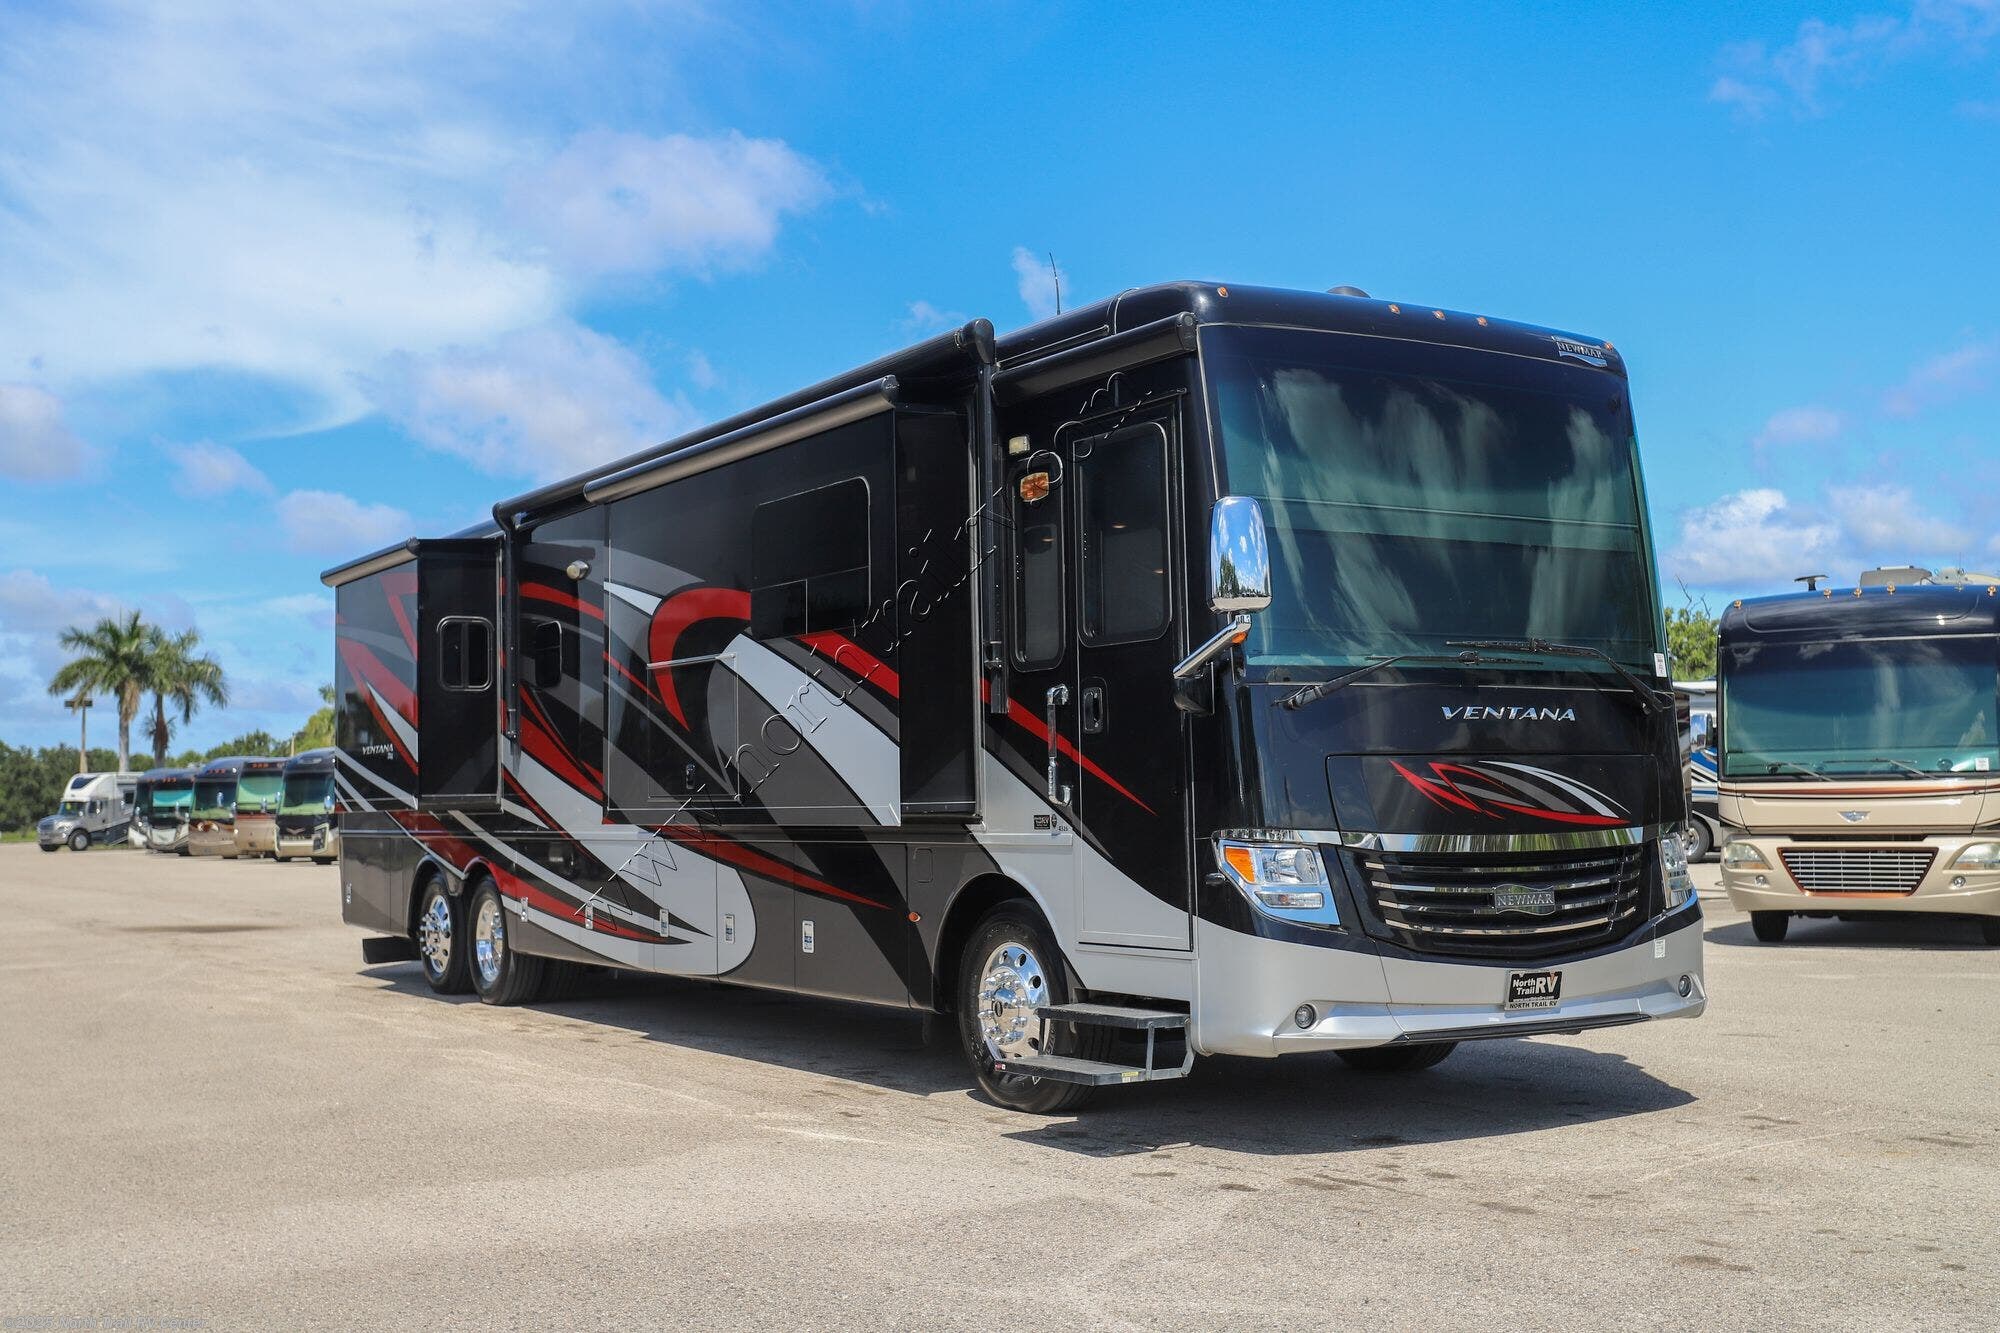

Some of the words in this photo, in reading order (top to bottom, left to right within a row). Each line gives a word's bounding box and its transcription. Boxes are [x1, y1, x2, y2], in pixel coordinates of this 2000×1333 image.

[1556, 341, 1604, 359] NEWMAR
[1441, 706, 1576, 721] VENTANA
[362, 743, 394, 755] VENTANA
[1497, 893, 1554, 906] NEWMAR
[1512, 978, 1535, 988] North
[1535, 976, 1558, 994] RV
[1516, 987, 1535, 995] Trail
